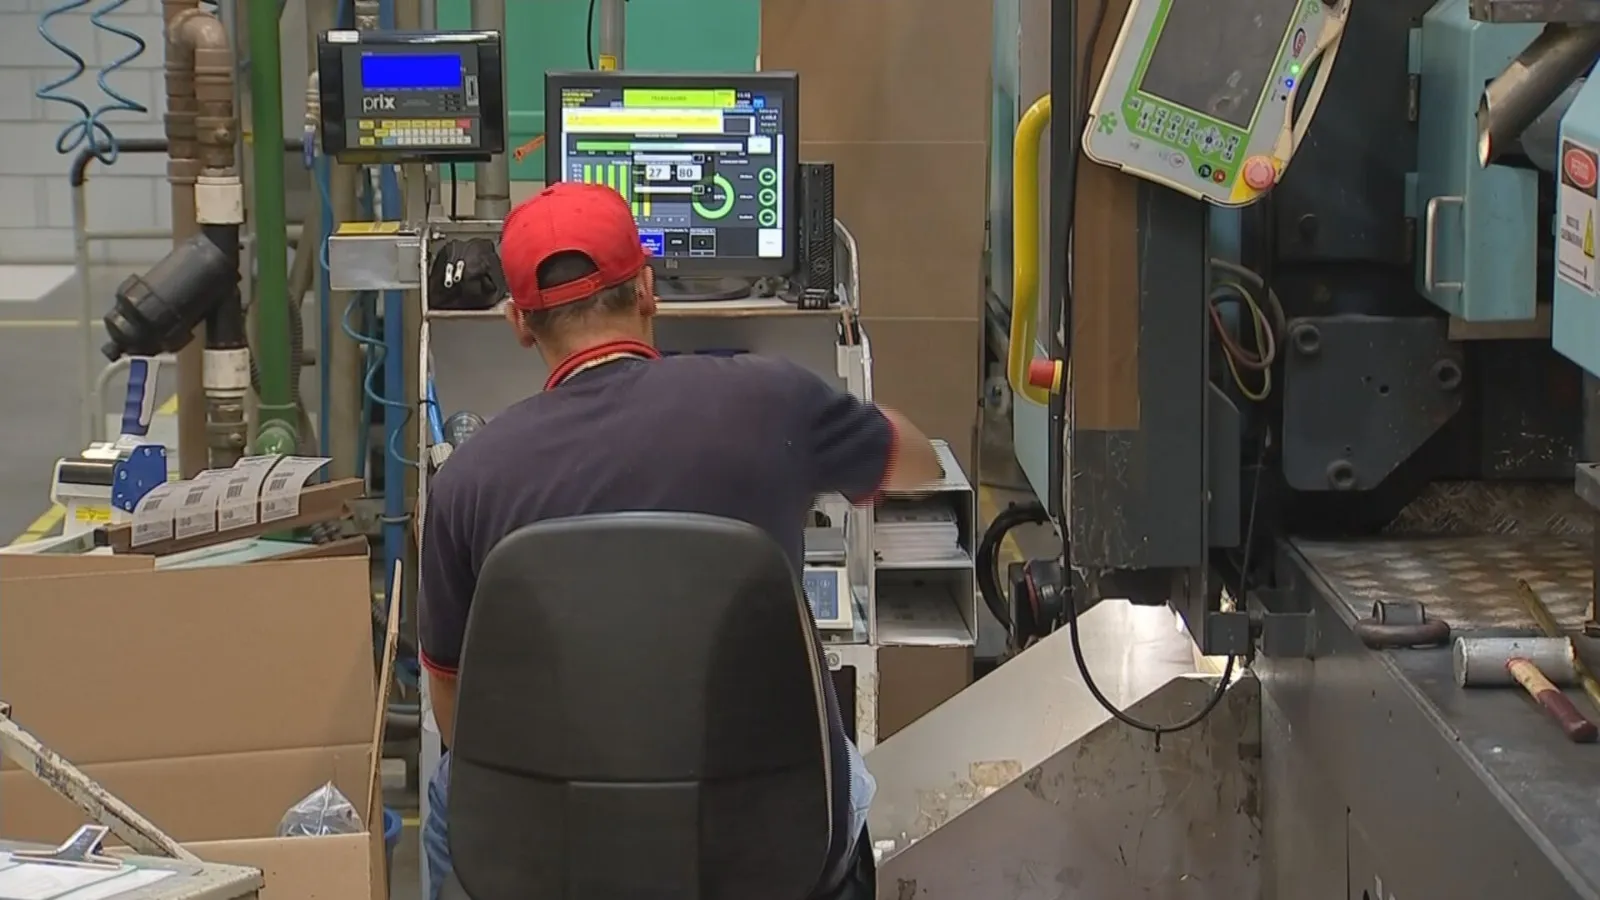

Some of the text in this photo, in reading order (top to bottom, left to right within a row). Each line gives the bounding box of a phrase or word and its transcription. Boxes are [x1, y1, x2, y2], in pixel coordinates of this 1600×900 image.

[362, 94, 396, 113] prix
[648, 168, 662, 177] 27
[679, 168, 693, 177] 80
